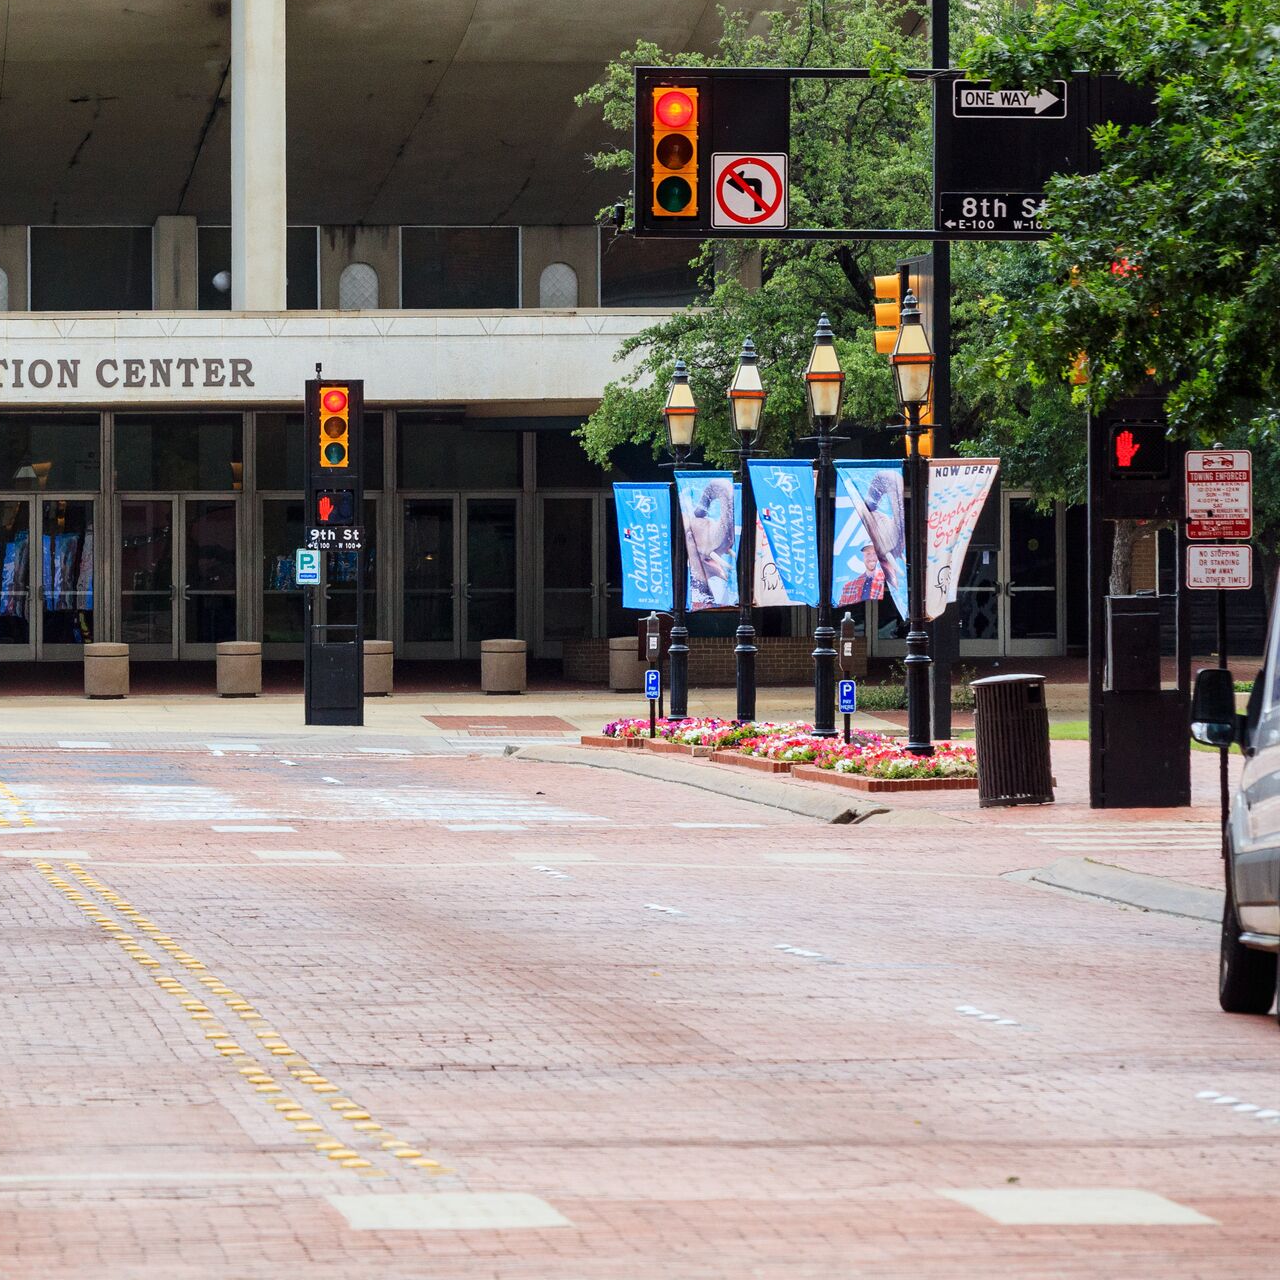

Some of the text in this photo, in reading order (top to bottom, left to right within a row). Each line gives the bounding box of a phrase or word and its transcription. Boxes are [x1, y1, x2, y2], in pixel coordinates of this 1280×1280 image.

[965, 92, 1030, 106] ONE WAY
[962, 198, 1007, 218] 8th
[958, 220, 995, 230] E-100
[95, 357, 256, 388] CENTER
[935, 465, 993, 478] NOW OPEN
[1190, 471, 1247, 481] TOWING ENFORCED
[310, 529, 360, 540] 9th St
[788, 504, 806, 585] SCHWAB
[805, 505, 815, 589] CHALLENGE
[300, 554, 314, 570] P
[624, 523, 648, 593] charles
[646, 523, 663, 594] SCHWAB
